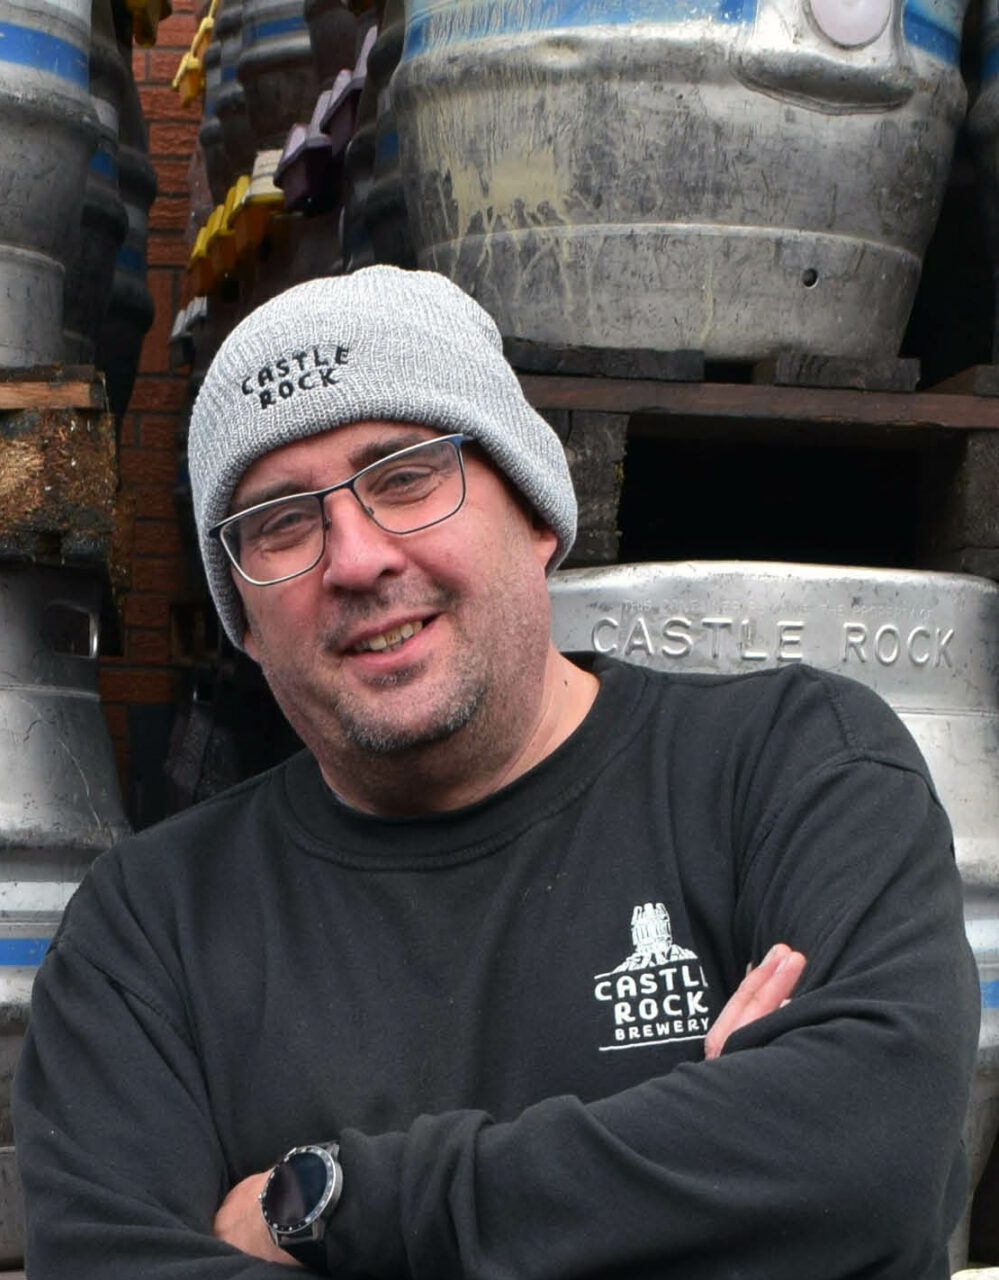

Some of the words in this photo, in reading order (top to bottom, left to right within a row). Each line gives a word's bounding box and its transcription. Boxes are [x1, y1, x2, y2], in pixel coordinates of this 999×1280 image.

[241, 346, 349, 395] CASTLE
[260, 368, 339, 410] ROCK
[591, 616, 805, 662] CASTLE
[842, 622, 955, 668] ROCK
[614, 991, 709, 1025] ROCK
[615, 1018, 709, 1041] BREWERY
